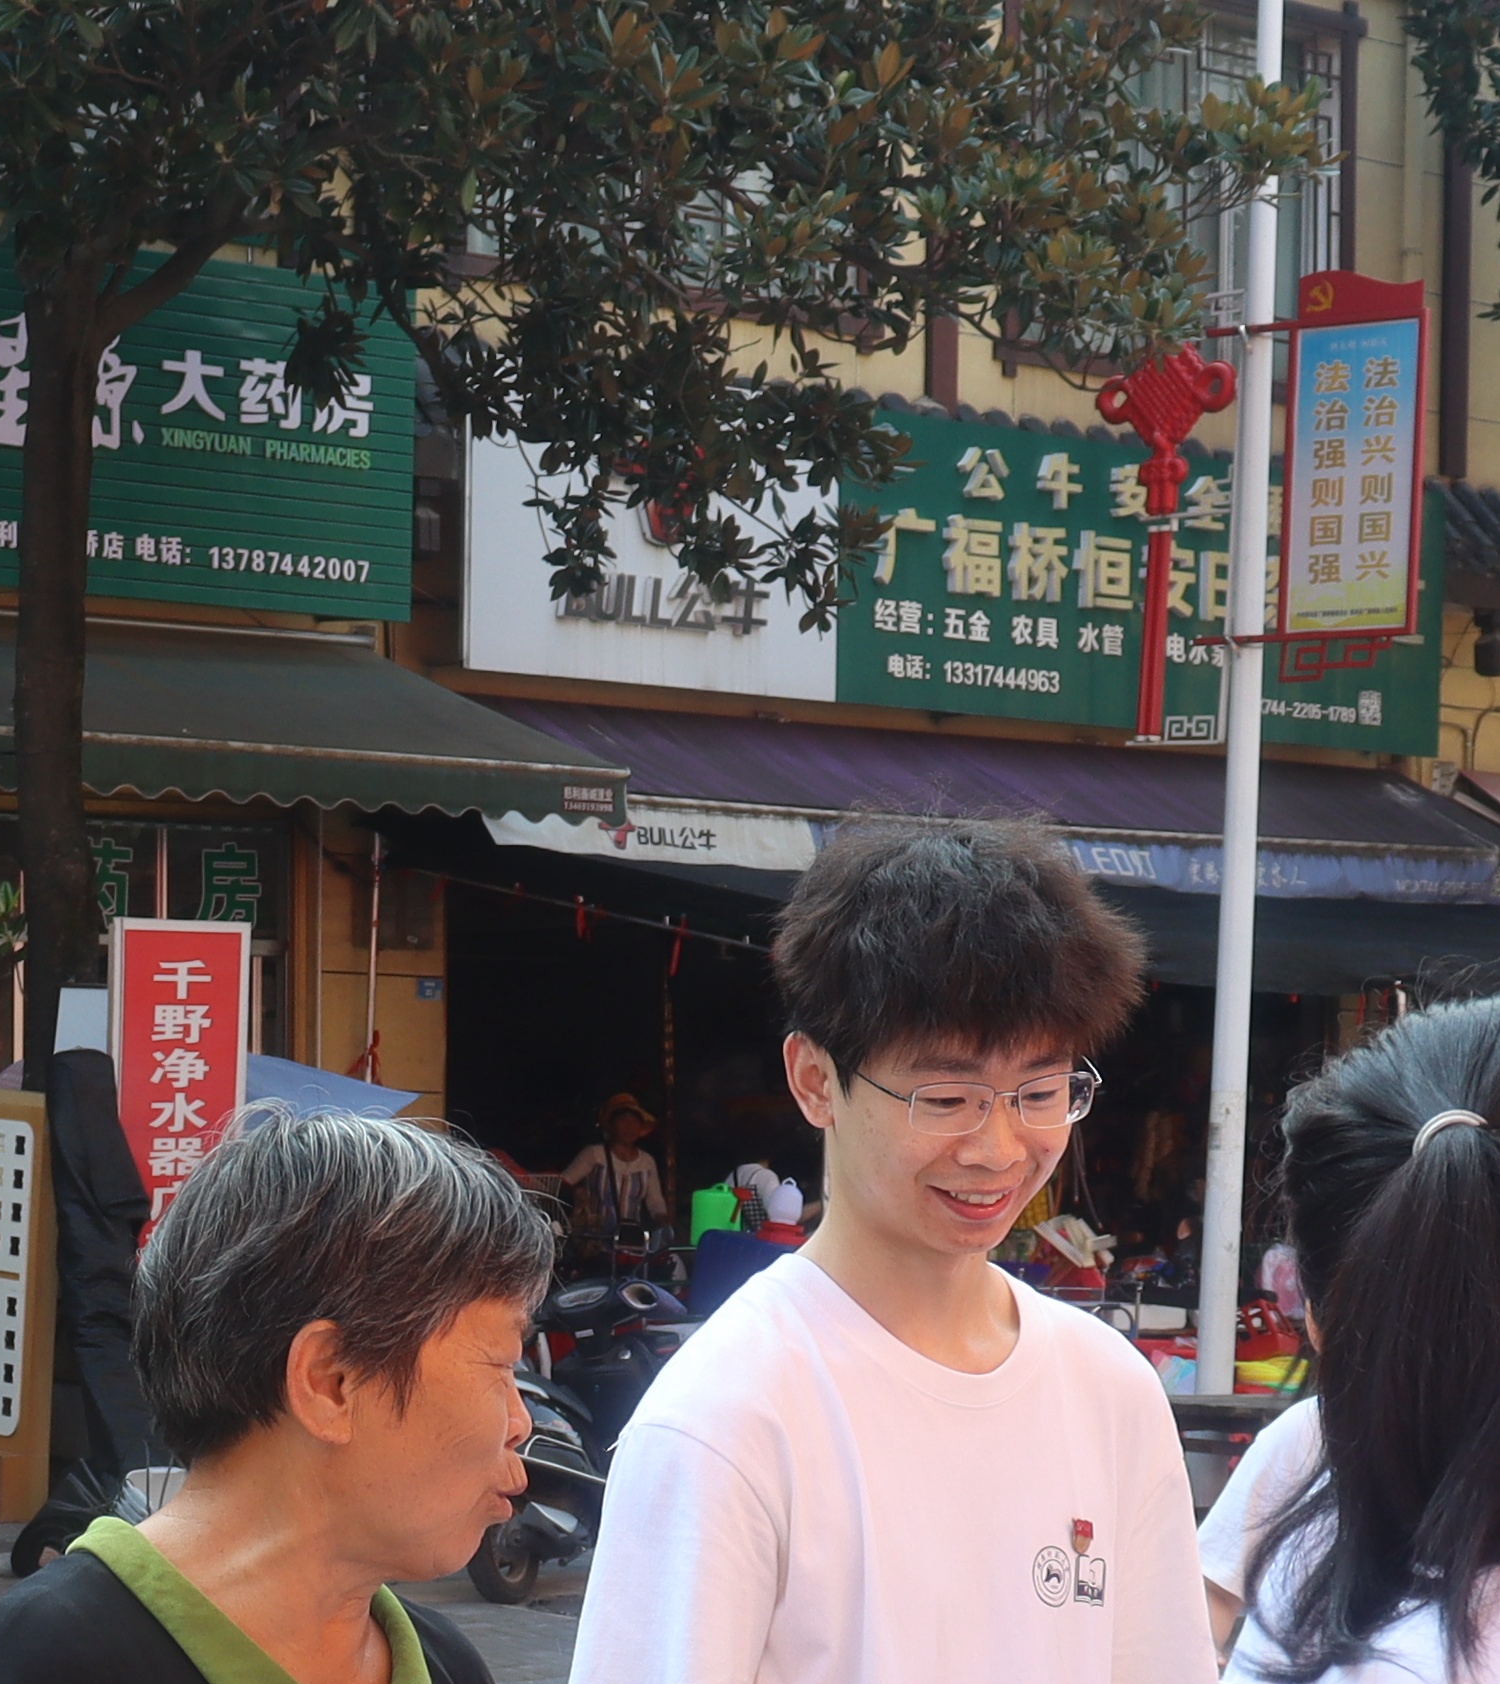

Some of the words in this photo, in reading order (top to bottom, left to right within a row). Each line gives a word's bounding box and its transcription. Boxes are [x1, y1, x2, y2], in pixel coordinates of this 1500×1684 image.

[161, 427, 252, 456] XINGYUAN
[264, 439, 372, 470] PHARMACIES
[956, 446, 1283, 537] 公牛安全
[1308, 360, 1350, 585] 法治强则国强
[1356, 356, 1399, 582] 法治兴则国兴
[873, 508, 1281, 629] 广福桥恒安日
[1011, 614, 1059, 649] 农具
[1078, 623, 1124, 656] 水管
